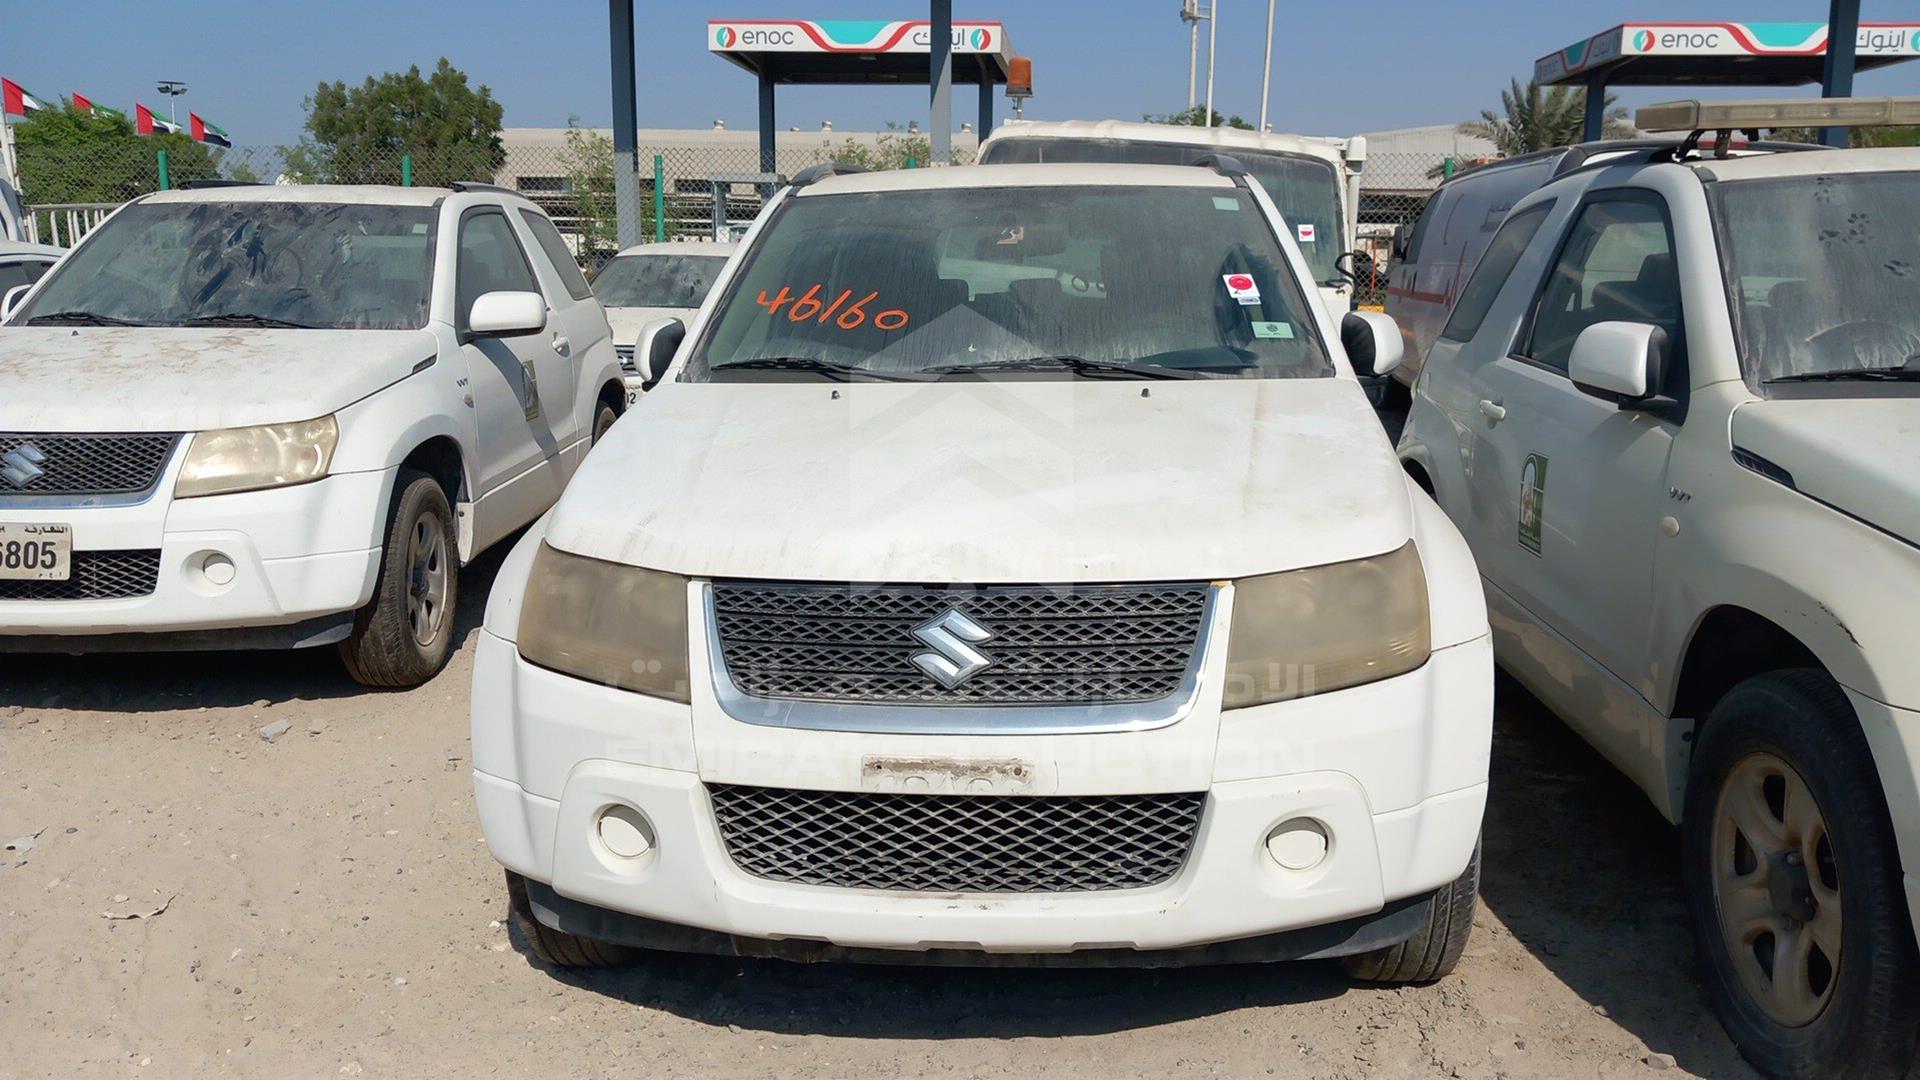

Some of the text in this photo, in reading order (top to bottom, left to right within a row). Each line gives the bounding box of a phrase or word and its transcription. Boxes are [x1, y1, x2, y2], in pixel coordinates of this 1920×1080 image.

[742, 29, 794, 45] enoc
[1661, 33, 1719, 48] enoc
[1855, 30, 1906, 52] اينوك
[757, 284, 909, 329] 46160
[0, 540, 57, 569] 805
